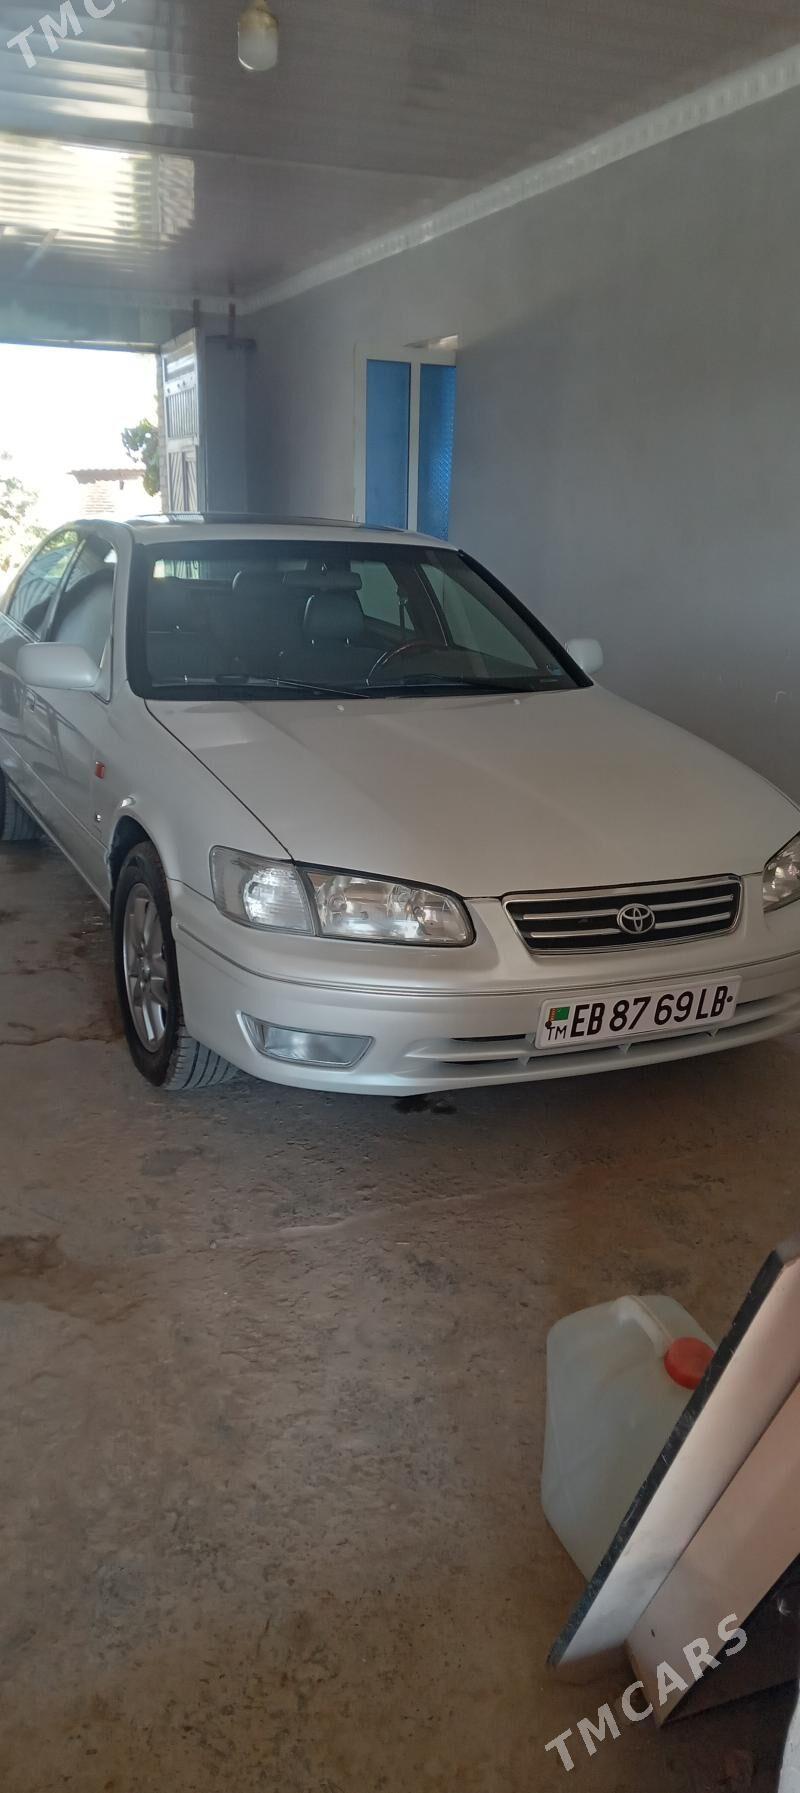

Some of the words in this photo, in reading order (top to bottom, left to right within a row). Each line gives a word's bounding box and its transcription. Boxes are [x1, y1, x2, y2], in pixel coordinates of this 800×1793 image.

[570, 1003, 605, 1037] EB
[609, 997, 651, 1031] 87
[654, 991, 693, 1025] 69
[696, 986, 728, 1019] LB
[547, 1025, 567, 1040] TM
